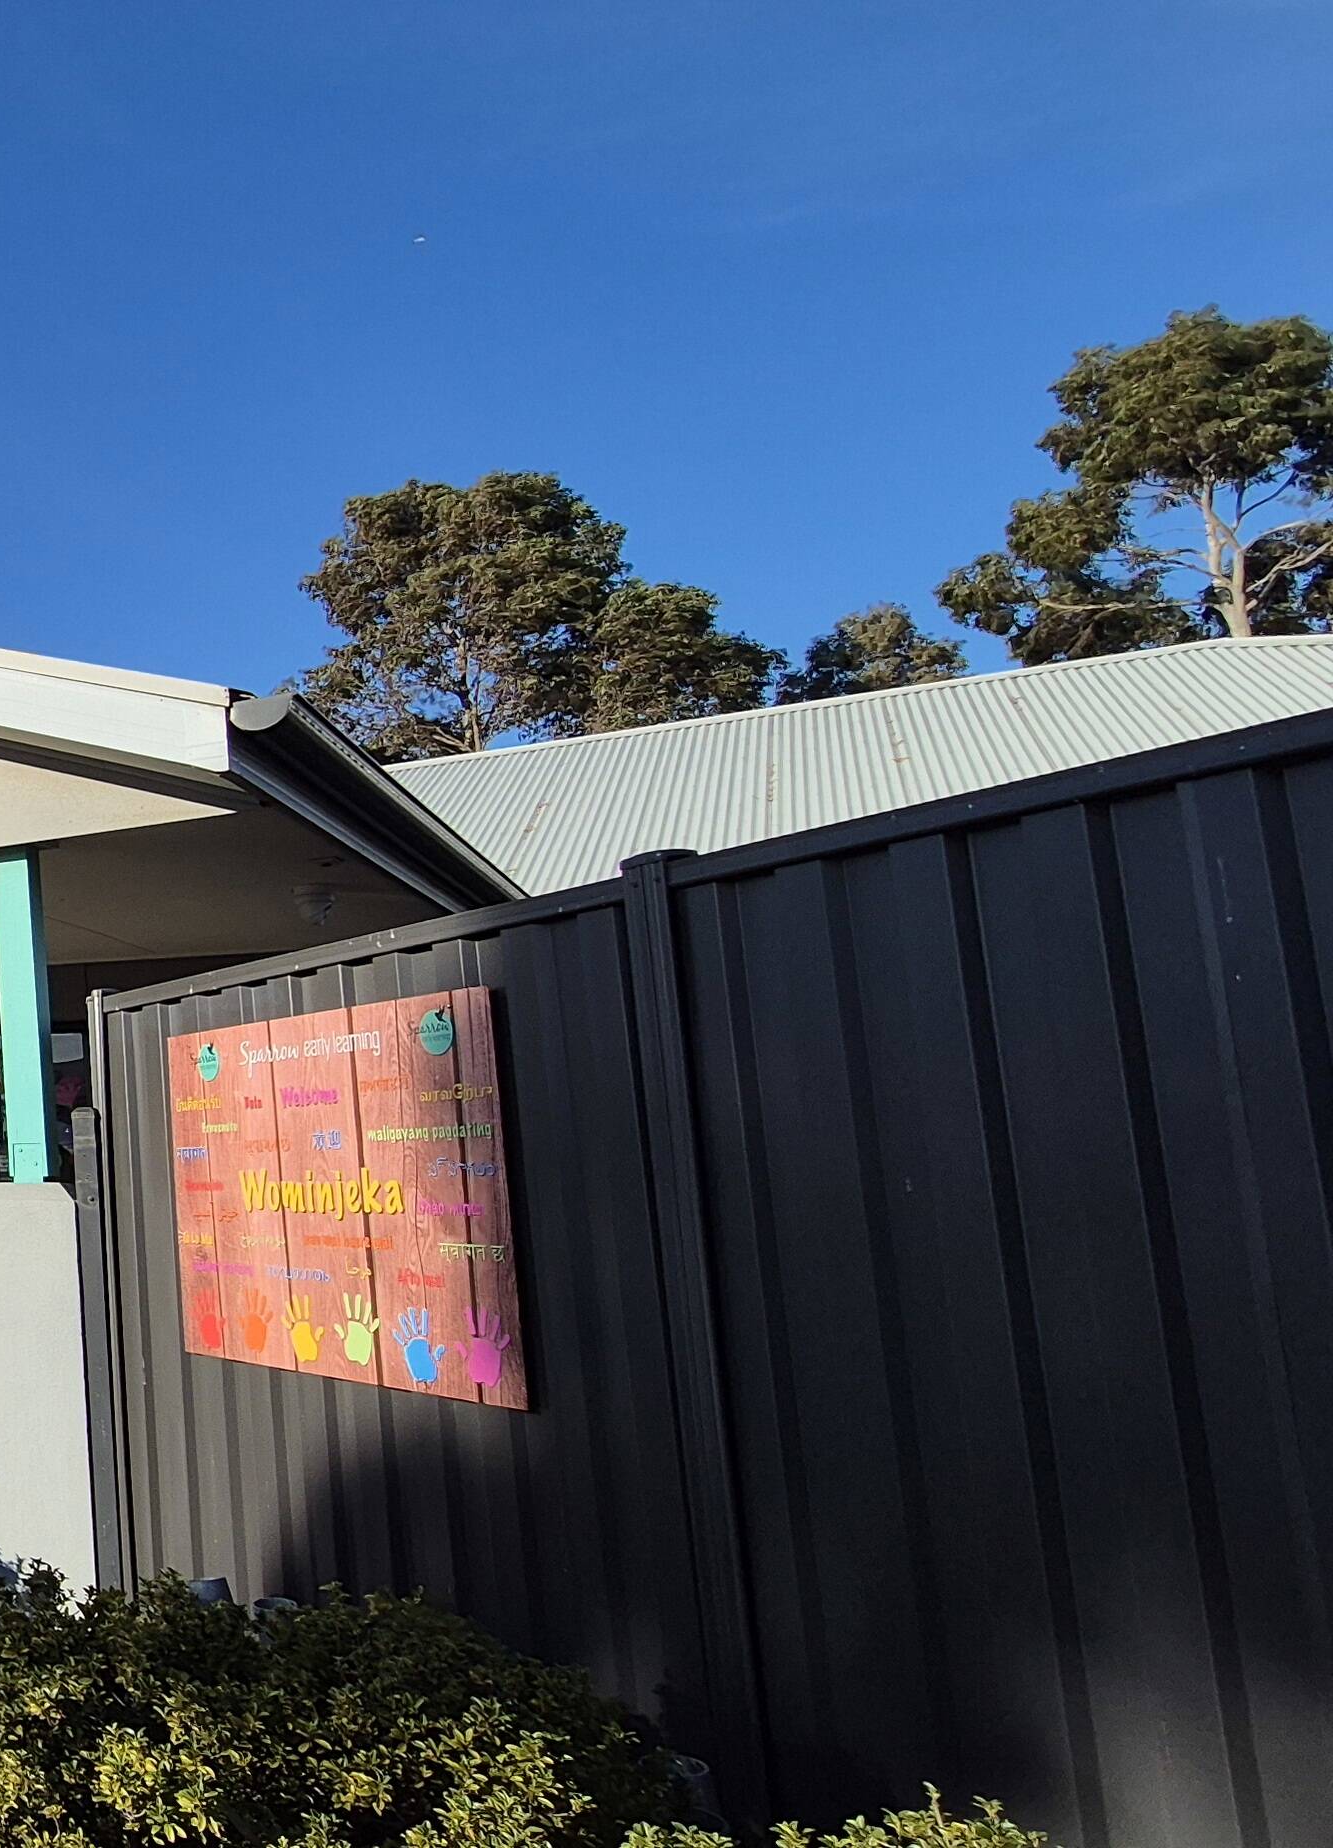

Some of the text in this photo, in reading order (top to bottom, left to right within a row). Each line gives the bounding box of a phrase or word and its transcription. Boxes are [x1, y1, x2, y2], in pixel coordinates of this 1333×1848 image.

[239, 1030, 381, 1079] Sparrow early learning
[279, 1085, 340, 1109] Welcome
[366, 1120, 492, 1144] maligayang pagdating
[238, 1167, 406, 1221] Wominjeka
